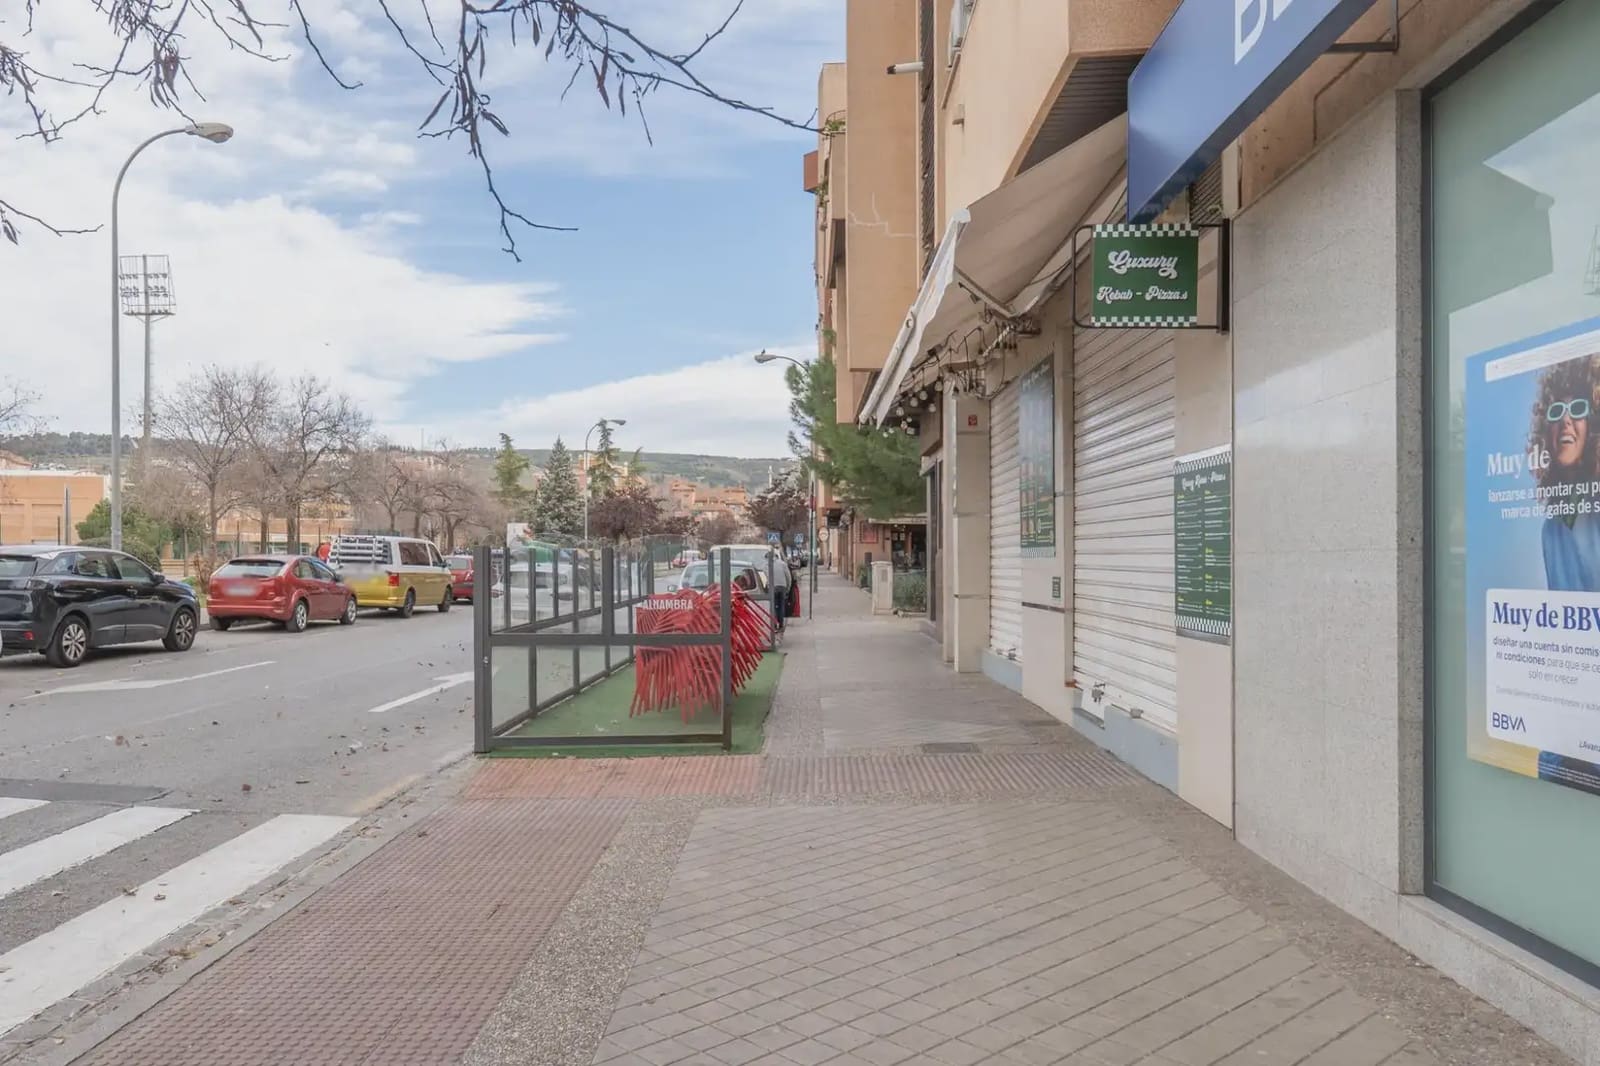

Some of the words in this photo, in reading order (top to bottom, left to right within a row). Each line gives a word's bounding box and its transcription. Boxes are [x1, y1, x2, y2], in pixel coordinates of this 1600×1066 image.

[1108, 250, 1178, 279] Luxury
[1096, 286, 1133, 304] Kebab
[1487, 452, 1524, 479] Muy
[1527, 443, 1551, 471] de
[1528, 488, 1535, 499] a
[1536, 482, 1574, 499] montar
[1575, 482, 1589, 495] su
[1501, 506, 1530, 520] marca
[1532, 503, 1546, 517] de
[1547, 500, 1575, 519] gafas
[1577, 498, 1592, 514] de
[643, 599, 693, 610] ALHAMBRA
[1493, 602, 1533, 632] Muy
[1535, 602, 1558, 629] de
[1493, 636, 1518, 648] diseñar
[1519, 640, 1533, 649] una
[1534, 642, 1560, 653] cuenta
[1561, 643, 1574, 654] sin
[1504, 653, 1546, 666] condiciones
[1492, 711, 1526, 733] BBVA
